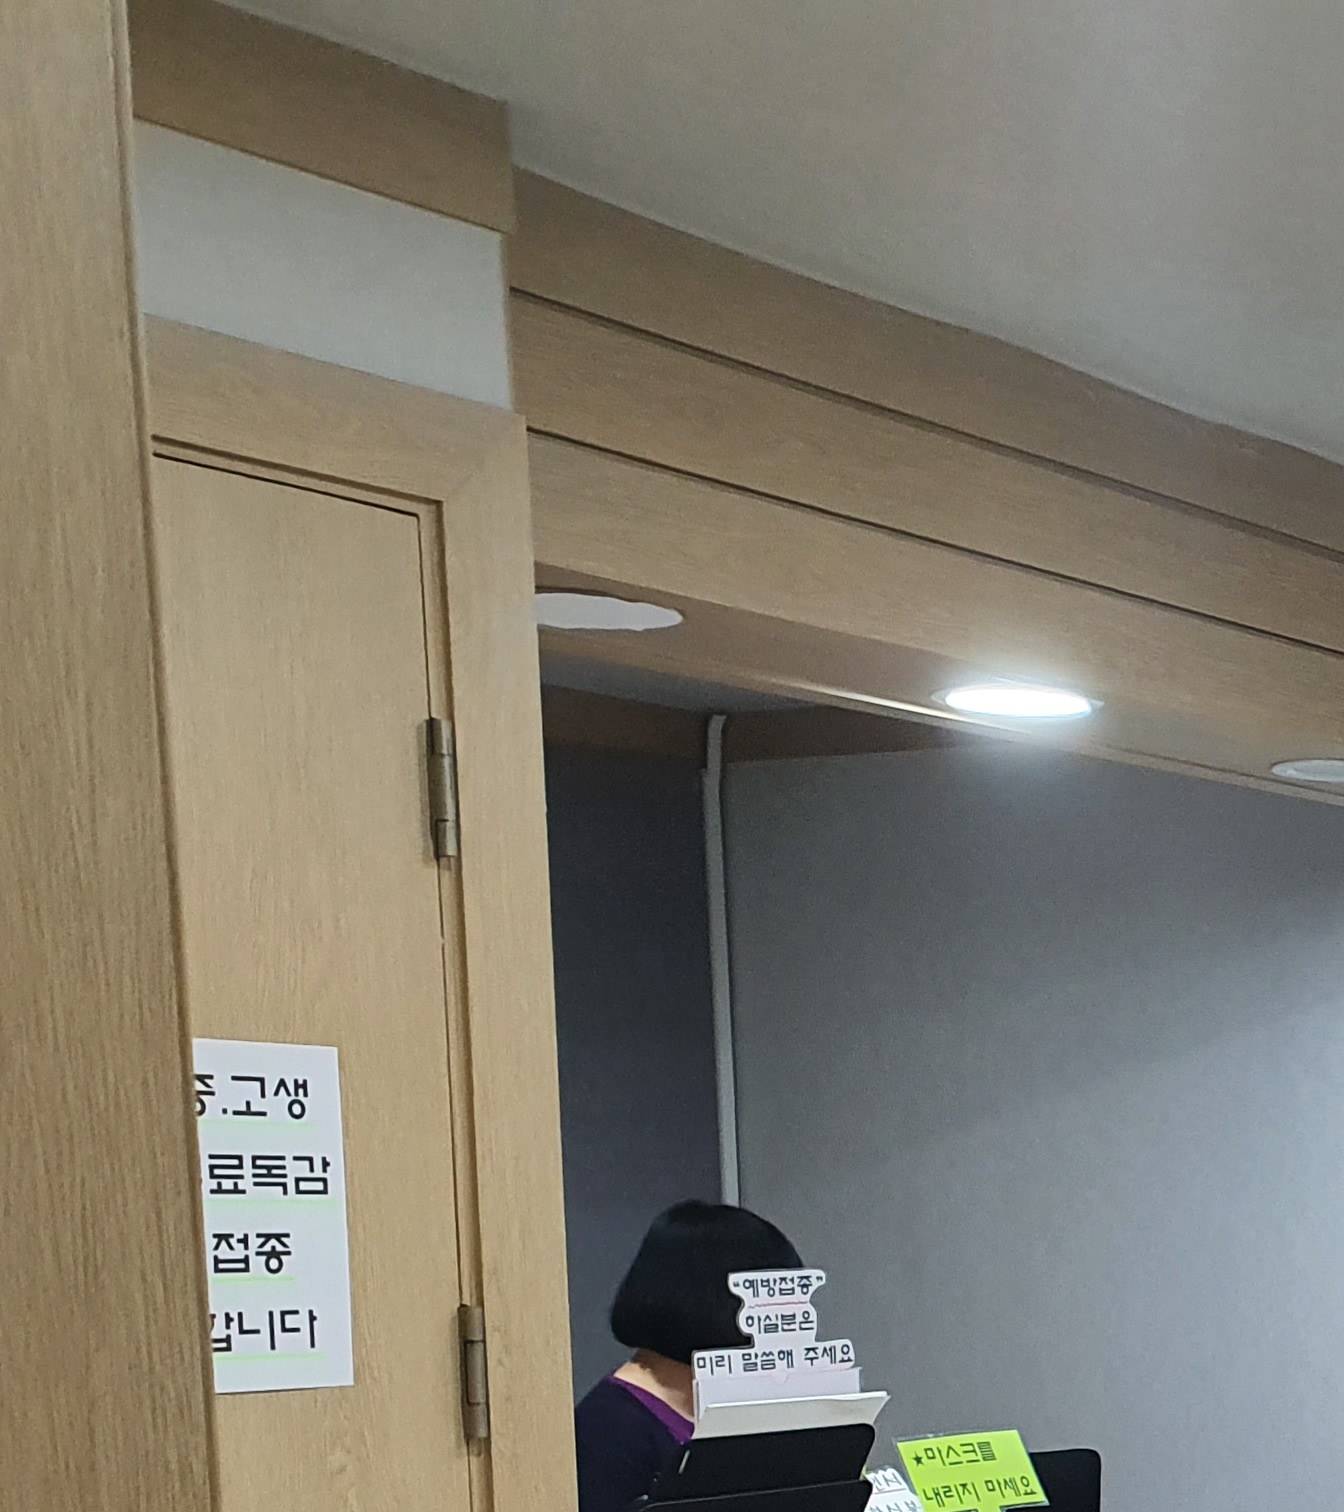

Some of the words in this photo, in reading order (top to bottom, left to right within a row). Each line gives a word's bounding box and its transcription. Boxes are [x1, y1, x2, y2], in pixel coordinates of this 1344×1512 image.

[212, 1232, 292, 1274] 접종
[745, 1310, 816, 1334] 하실분은
[696, 1352, 733, 1375] 미리
[741, 1348, 795, 1371] 말씀해
[803, 1343, 855, 1366] 주세요
[922, 1482, 981, 1508] 내리지
[984, 1475, 1037, 1499] 마세요
